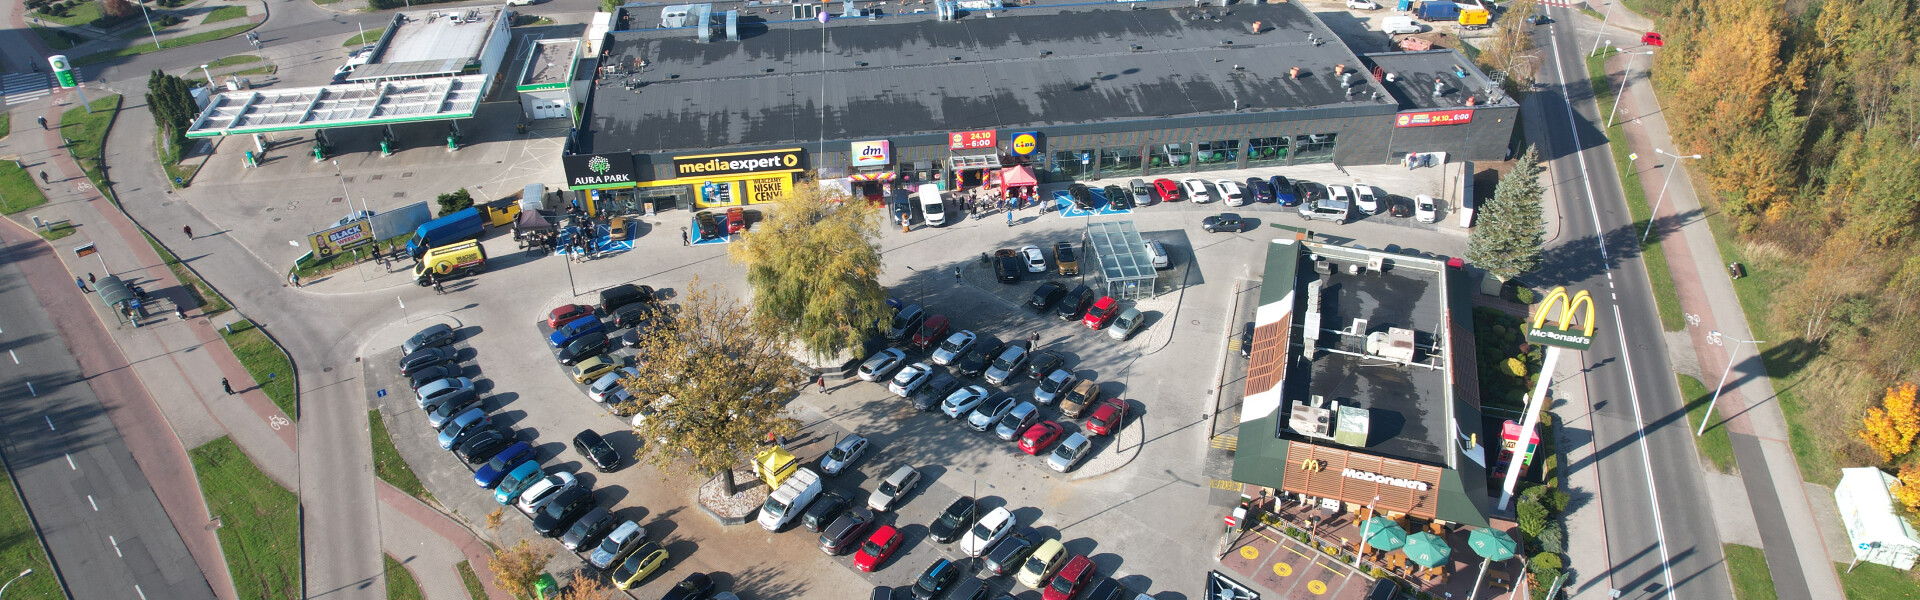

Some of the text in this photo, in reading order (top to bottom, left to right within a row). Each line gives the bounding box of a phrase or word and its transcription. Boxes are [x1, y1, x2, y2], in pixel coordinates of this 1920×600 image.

[970, 131, 991, 140] 24.10
[862, 145, 881, 156] dm
[679, 155, 781, 174] mediaexpert
[574, 173, 630, 185] AURA PARK
[754, 182, 782, 193] NISKIE
[330, 225, 361, 242] BLACK
[1529, 328, 1590, 345] McDonald's
